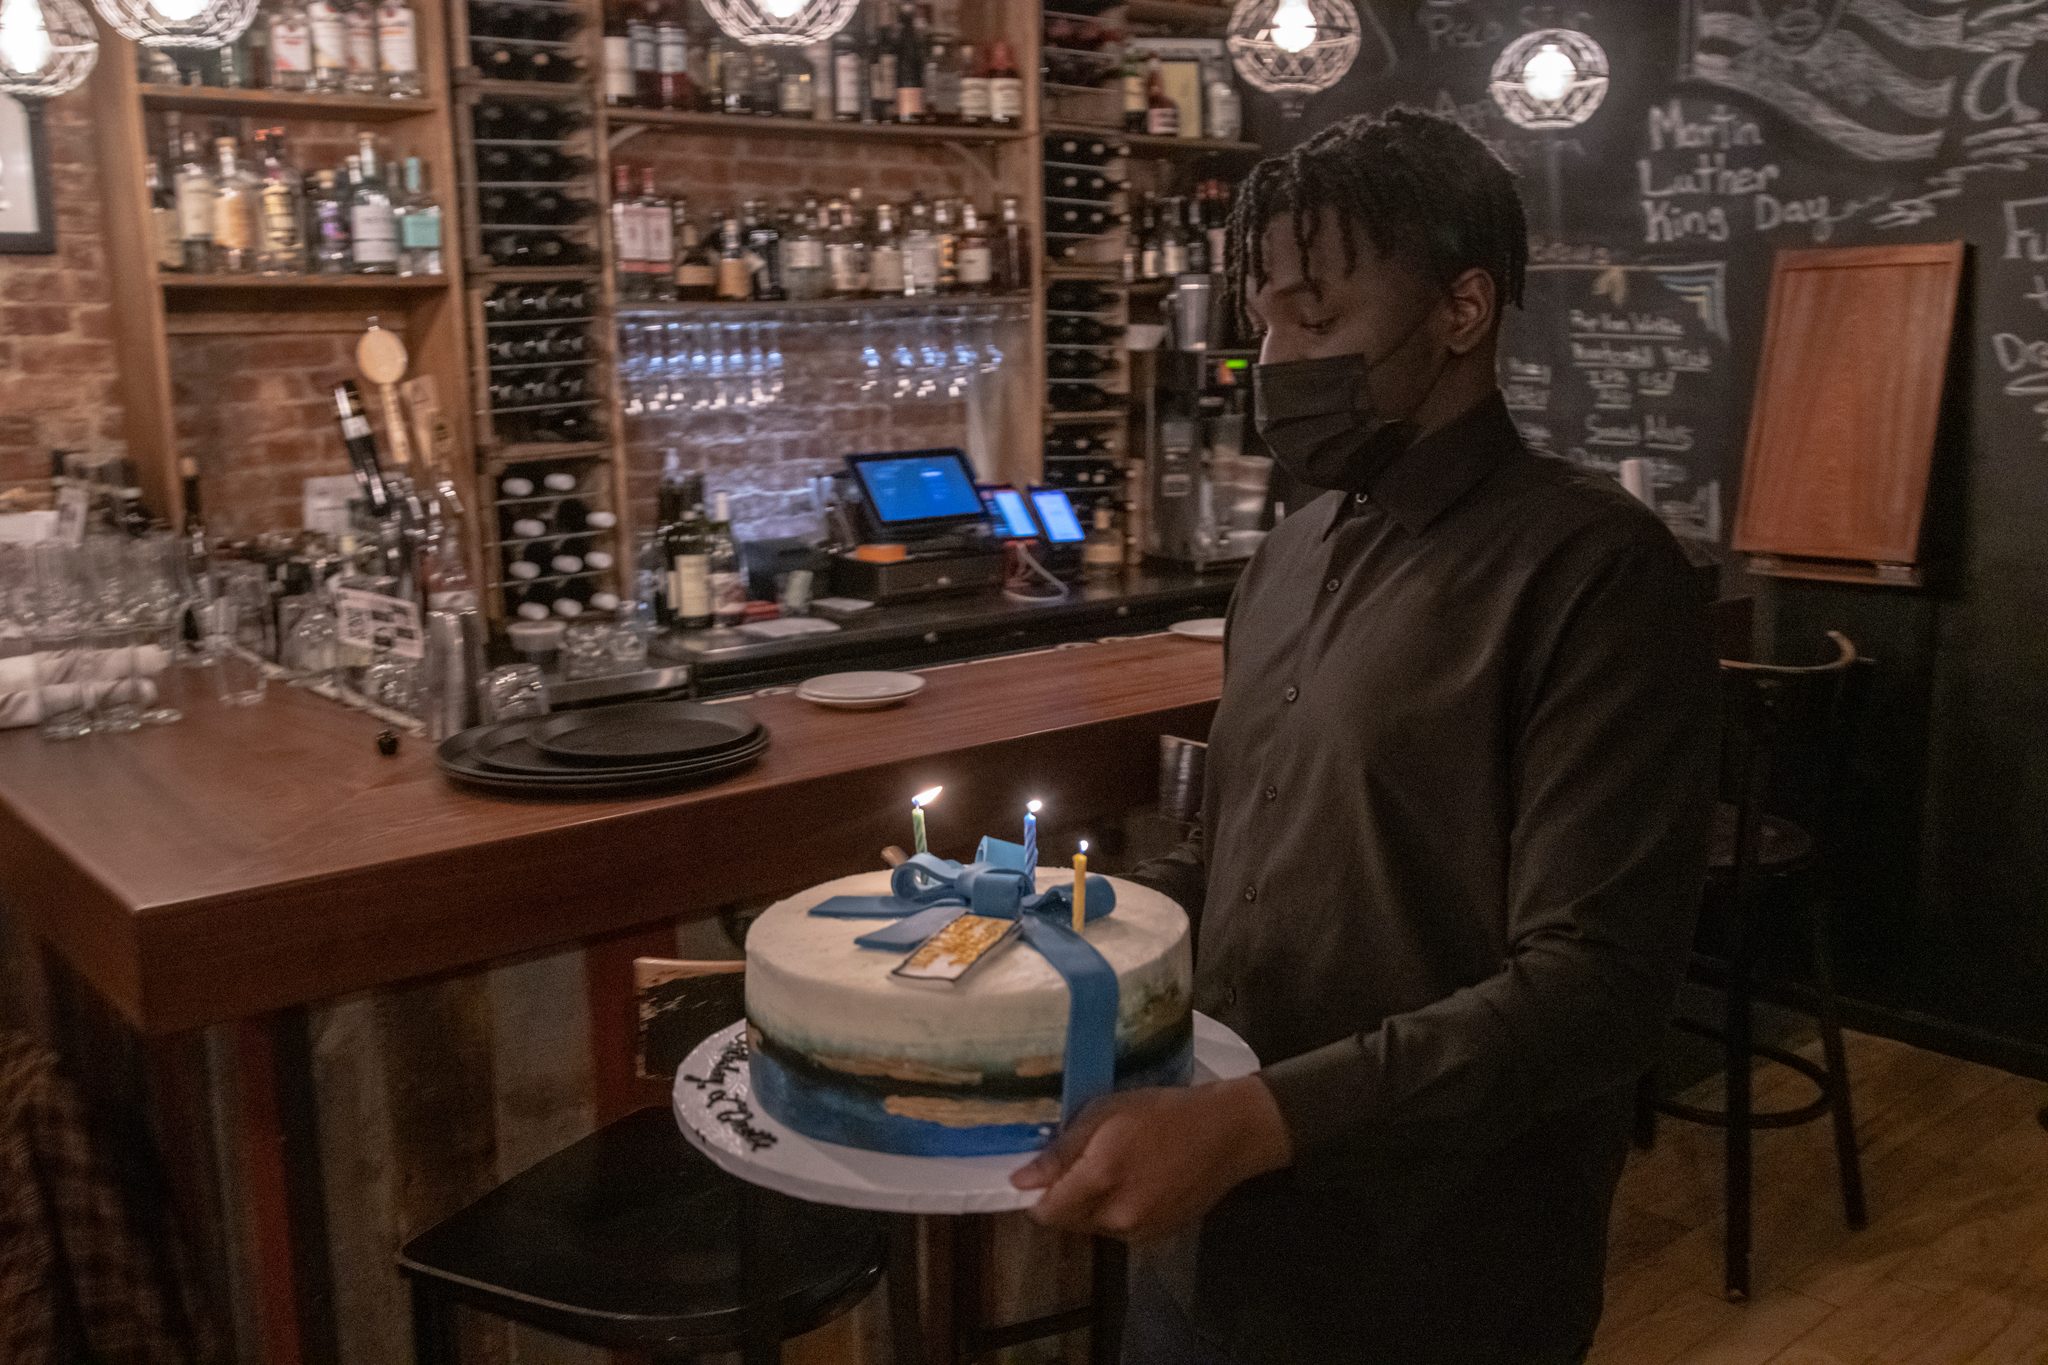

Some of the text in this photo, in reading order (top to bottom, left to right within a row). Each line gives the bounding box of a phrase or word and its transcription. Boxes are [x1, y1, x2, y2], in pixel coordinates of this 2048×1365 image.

[1648, 98, 1765, 151] Martin
[1636, 152, 1781, 197] Luther
[1642, 193, 1838, 243] King Day
